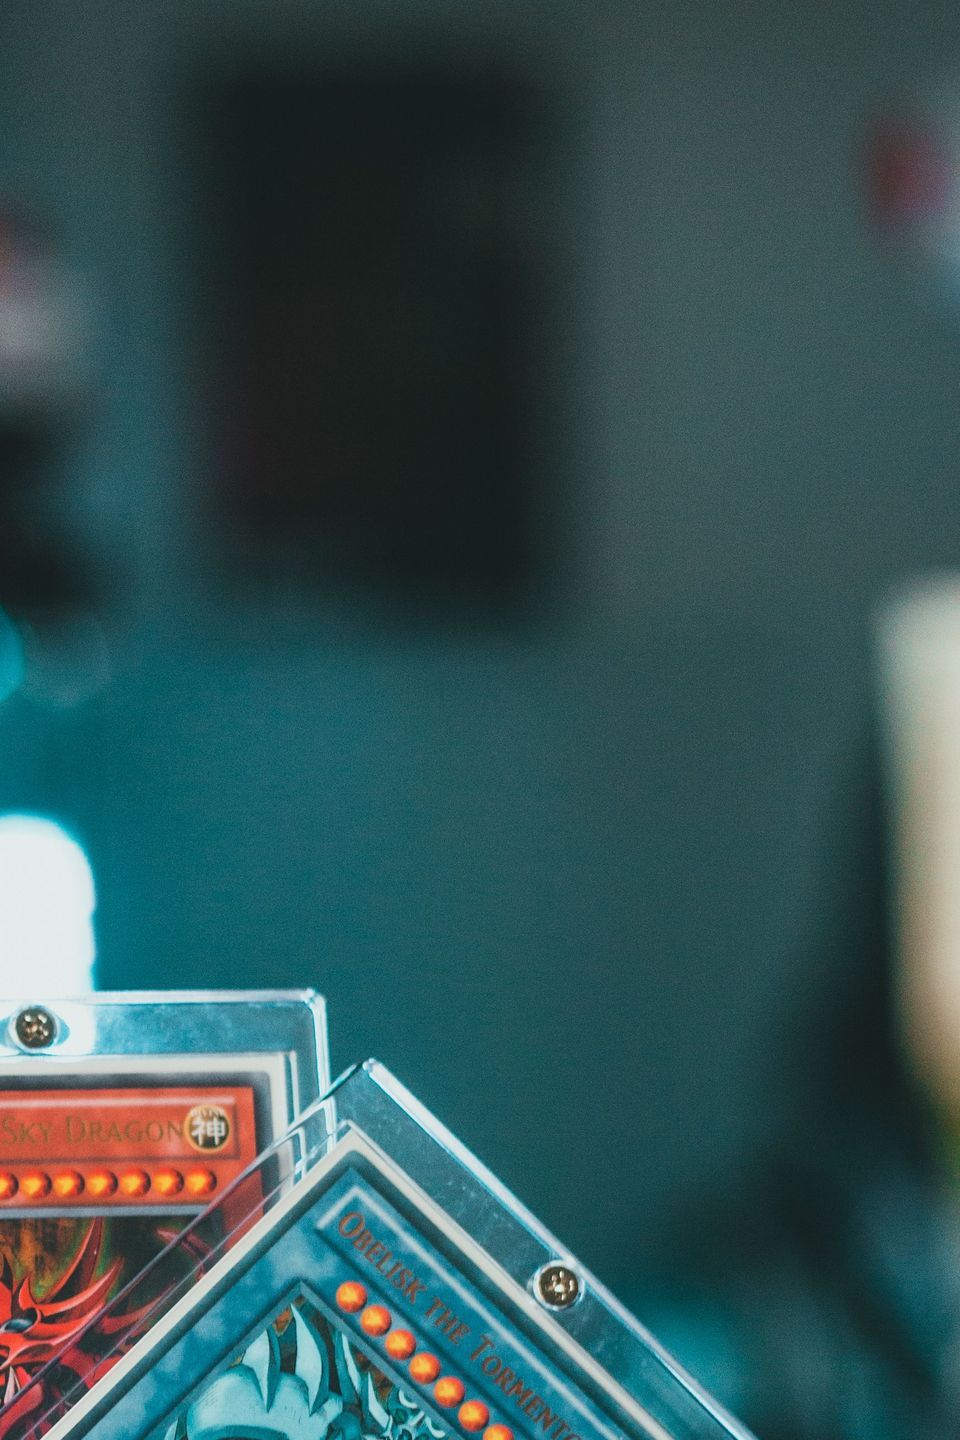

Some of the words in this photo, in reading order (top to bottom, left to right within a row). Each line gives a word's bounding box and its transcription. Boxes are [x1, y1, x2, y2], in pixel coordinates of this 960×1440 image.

[191, 1116, 224, 1145] 神
[337, 1212, 426, 1302] OBELISK
[421, 1295, 472, 1345] THE
